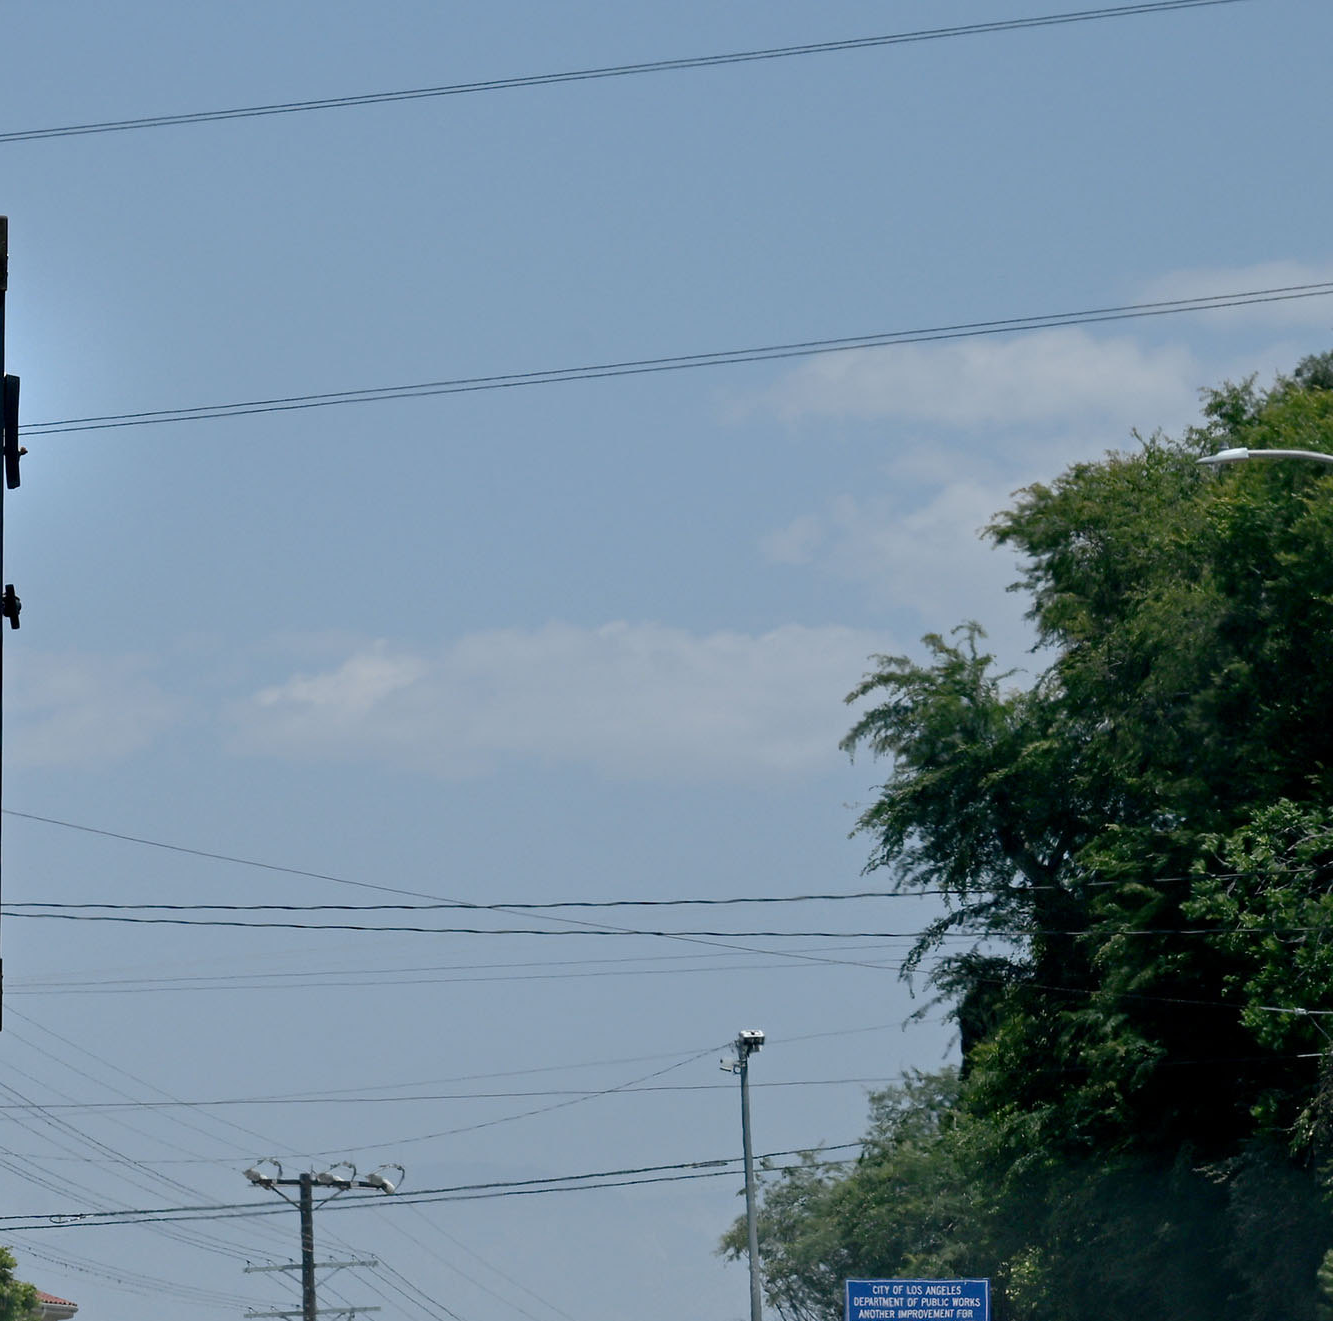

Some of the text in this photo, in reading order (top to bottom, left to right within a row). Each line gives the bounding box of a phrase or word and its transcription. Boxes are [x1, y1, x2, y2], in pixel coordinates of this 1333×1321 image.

[872, 1285, 962, 1296] CITY OF LOS ANGELES
[853, 1297, 981, 1307] DEPARTMENT OF PUBLIC WORKS
[858, 1309, 973, 1319] ANOTHER IMPROVEMENT FOR
